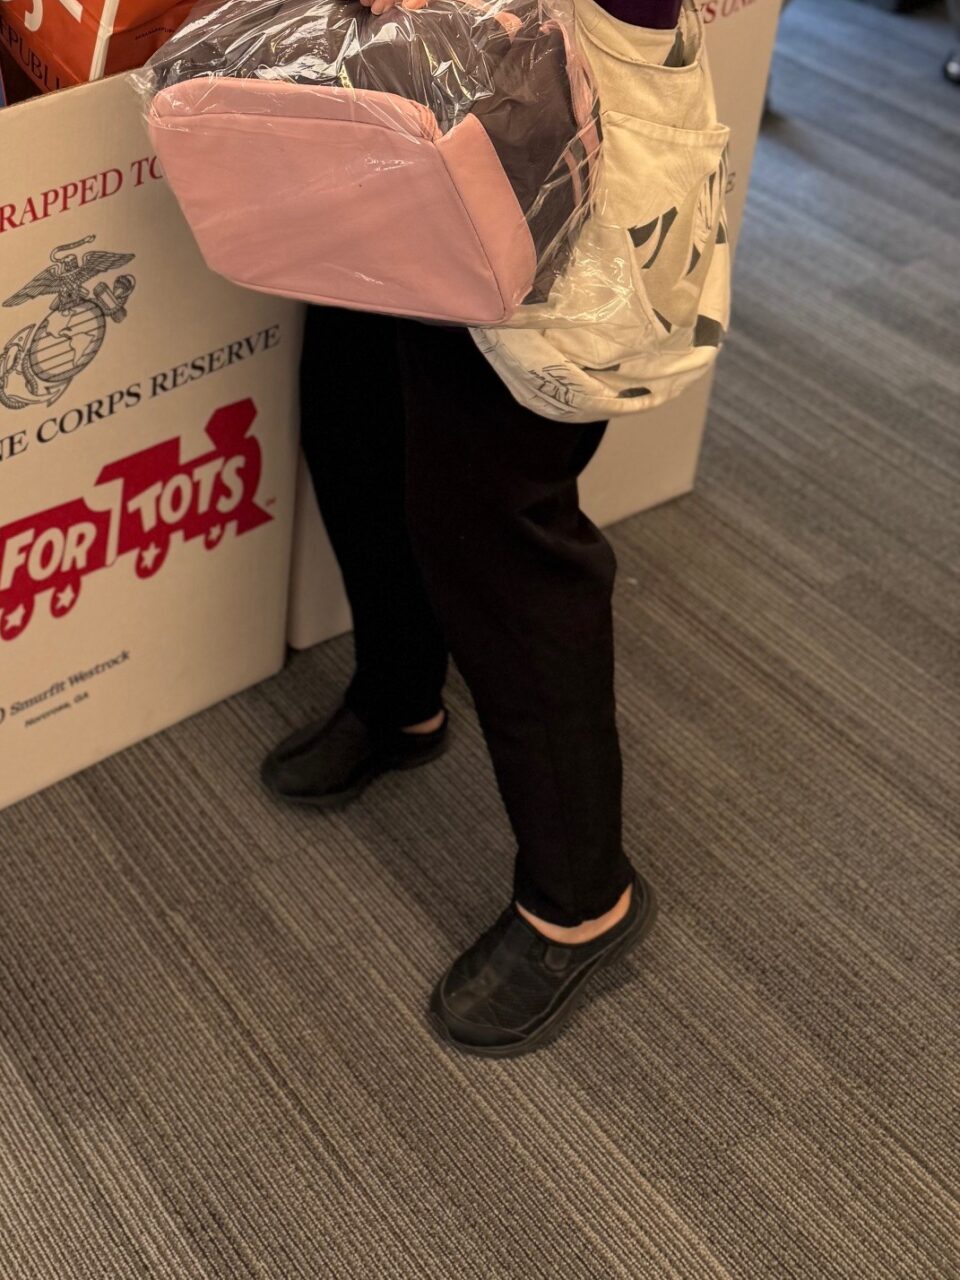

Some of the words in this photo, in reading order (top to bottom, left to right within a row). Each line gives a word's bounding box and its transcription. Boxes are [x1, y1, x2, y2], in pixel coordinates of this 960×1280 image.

[35, 383, 142, 444] CORPS
[148, 324, 281, 399] RESERVE
[126, 454, 246, 533] TOTS
[9, 680, 66, 717] Smurfit
[68, 649, 130, 688] Westrock
